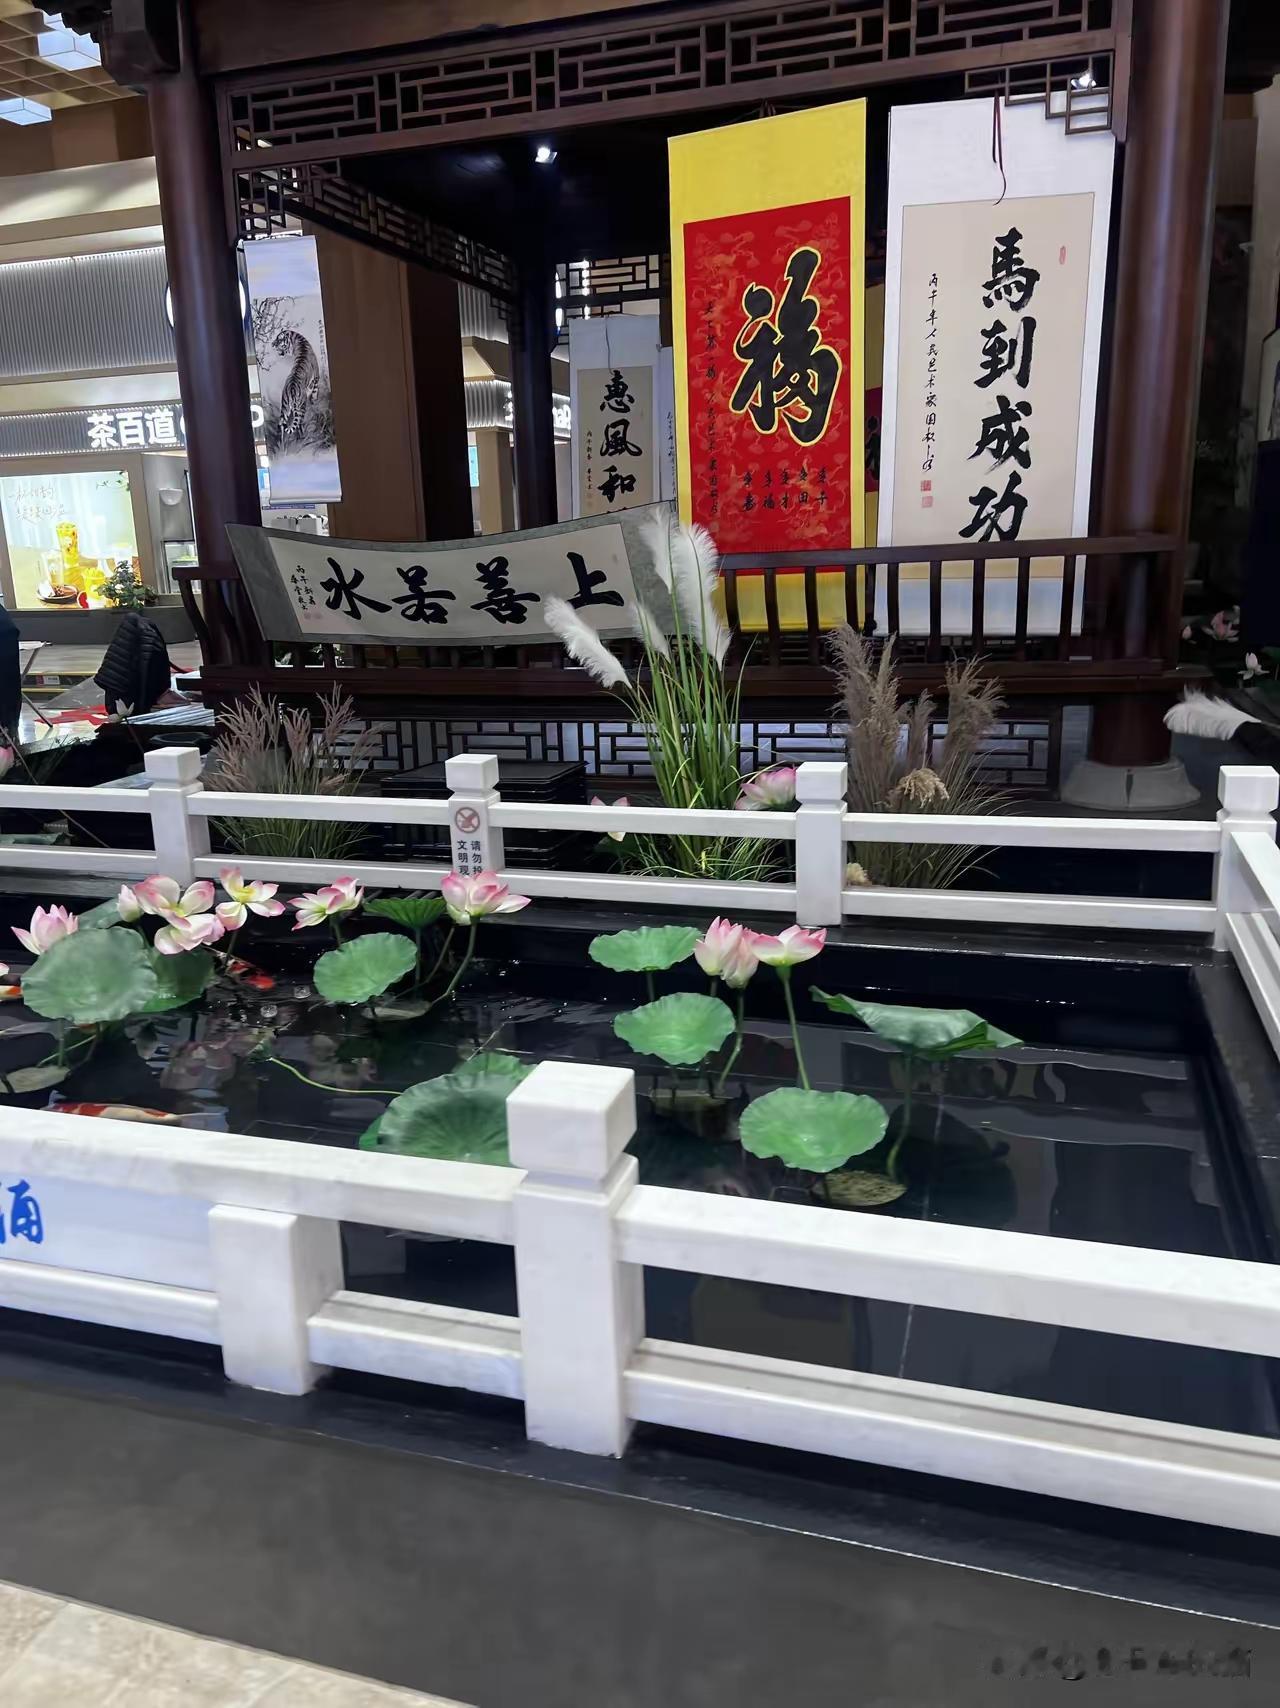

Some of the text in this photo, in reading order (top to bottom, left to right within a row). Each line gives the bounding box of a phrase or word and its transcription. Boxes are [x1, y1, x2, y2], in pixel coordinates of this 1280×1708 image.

[729, 245, 842, 447] 福
[86, 408, 177, 448] 茶百道
